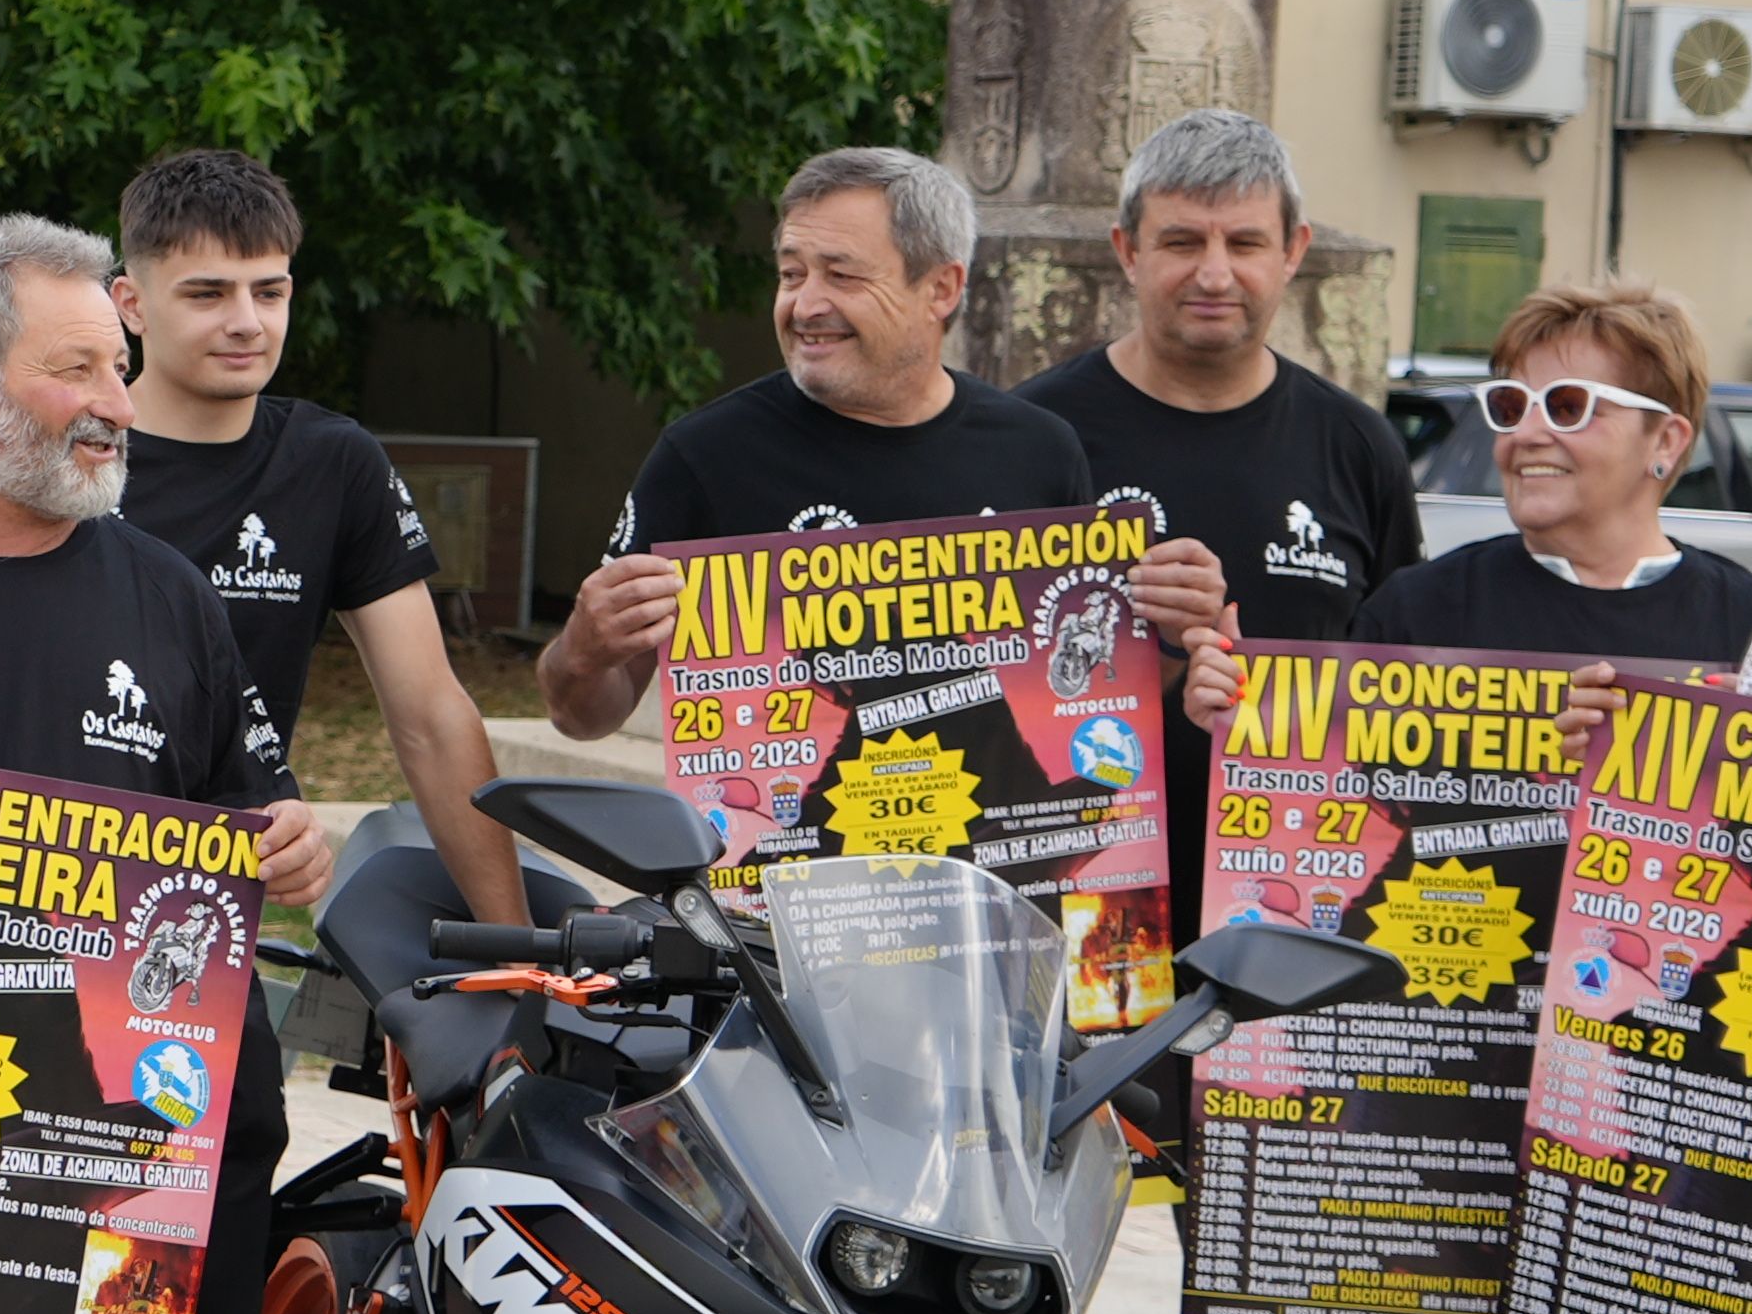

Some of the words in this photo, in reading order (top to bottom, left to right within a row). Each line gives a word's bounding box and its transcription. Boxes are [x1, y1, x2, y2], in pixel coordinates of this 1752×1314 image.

[211, 564, 232, 587] Os
[235, 565, 302, 590] Castaños
[1265, 542, 1287, 564] Os
[666, 551, 769, 661] XIV
[780, 509, 1146, 592] CONCENTRACIÓN
[782, 576, 1024, 650] MOTEIRA
[670, 665, 772, 694] Trasnos
[777, 658, 808, 685] do
[814, 646, 901, 681] Salnés
[906, 634, 1028, 672] Motoclub
[82, 710, 105, 735] Os
[673, 698, 723, 741] 26
[734, 702, 755, 728] e
[766, 688, 814, 733] 27
[1225, 654, 1339, 759] XIV
[676, 746, 744, 777] xuño
[749, 738, 817, 770] 2026
[1592, 687, 1719, 810] XIV
[1223, 762, 1328, 794] Trasnos
[1335, 769, 1366, 796] do
[1374, 770, 1464, 801] Salnés
[1471, 776, 1579, 807] Motocl
[1219, 795, 1270, 838] 26
[1283, 806, 1304, 832] e
[1316, 800, 1368, 843] 27
[1588, 800, 1692, 847] Trasnos
[1698, 824, 1731, 855] do
[1218, 845, 1286, 874] xuño
[1295, 850, 1364, 877] 2026
[1575, 834, 1630, 884] 26
[1641, 855, 1665, 884] e
[1675, 855, 1731, 903] 27
[1570, 886, 1641, 927] xuño
[1648, 902, 1722, 942] 2026
[127, 1016, 214, 1041] MOTOCLUB
